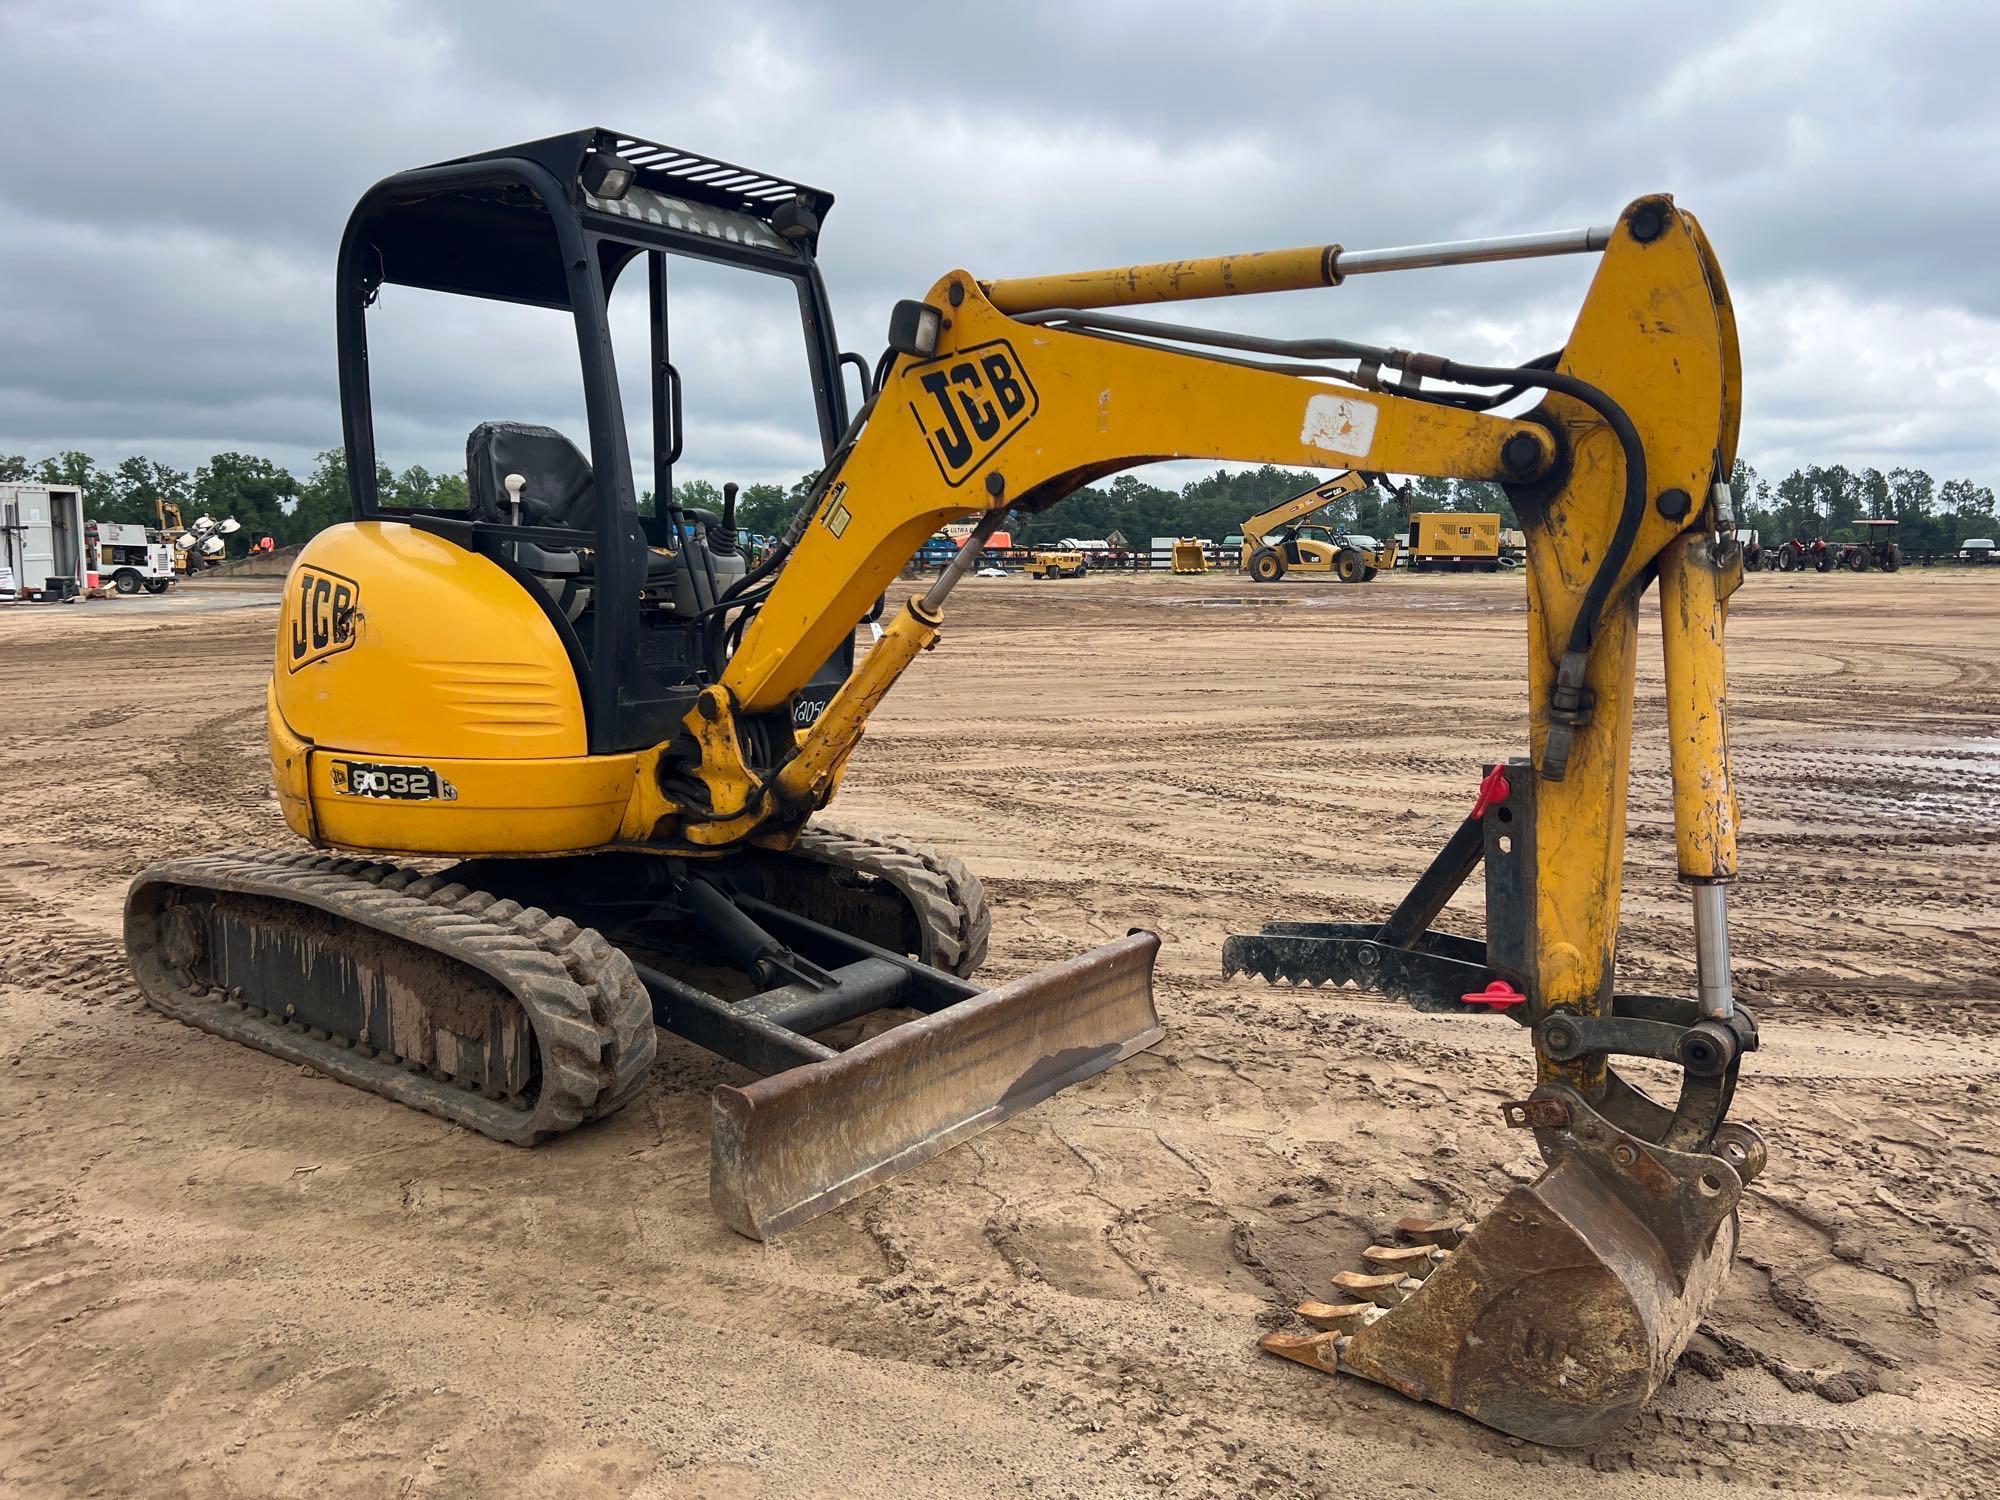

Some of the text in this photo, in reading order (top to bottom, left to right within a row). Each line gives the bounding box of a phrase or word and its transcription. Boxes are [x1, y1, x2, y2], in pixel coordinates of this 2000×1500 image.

[920, 353, 1025, 469] JCB
[292, 575, 352, 660] JCB
[353, 770, 430, 794] 8032
